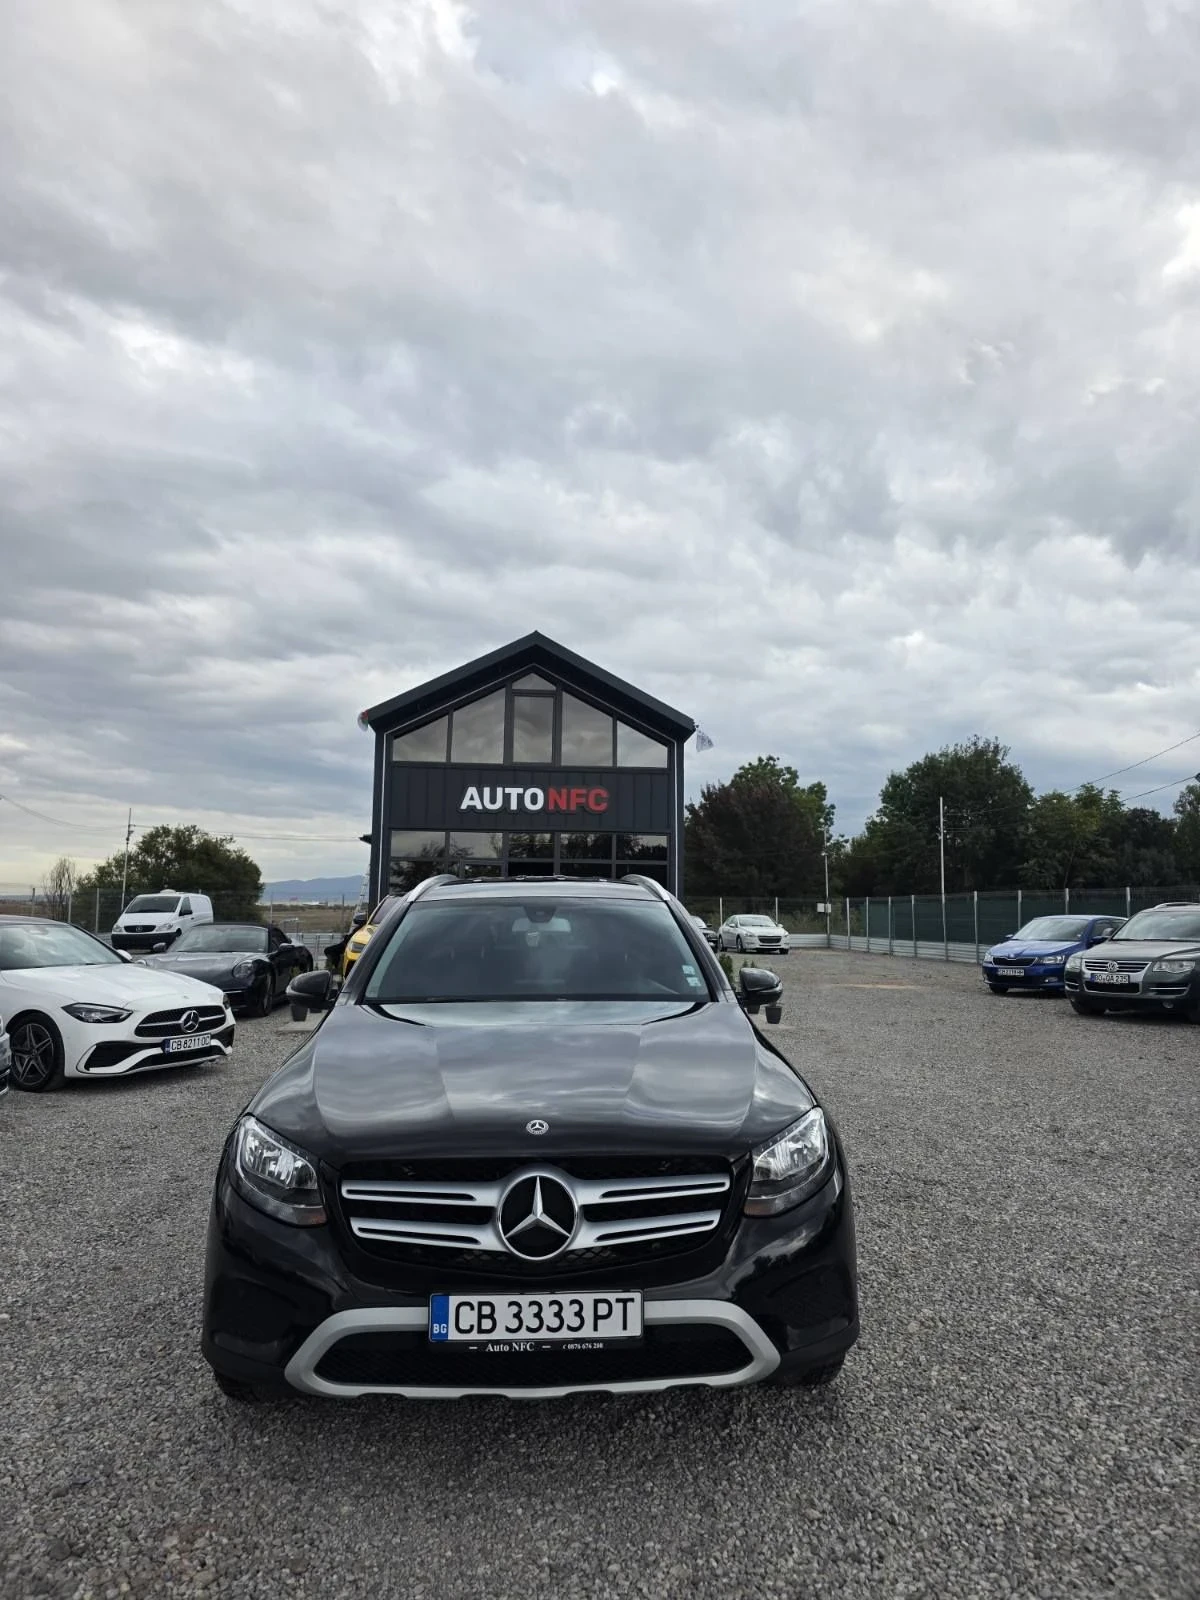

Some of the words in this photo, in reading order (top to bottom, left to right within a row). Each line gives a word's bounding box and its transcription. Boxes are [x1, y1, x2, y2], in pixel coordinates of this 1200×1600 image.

[183, 1038, 200, 1048] 8211
[433, 1323, 448, 1334] BG
[454, 1301, 497, 1335] CB
[505, 1299, 585, 1333] 3333
[593, 1297, 635, 1332] PT
[486, 1343, 509, 1352] Auto
[512, 1342, 535, 1352] NFC
